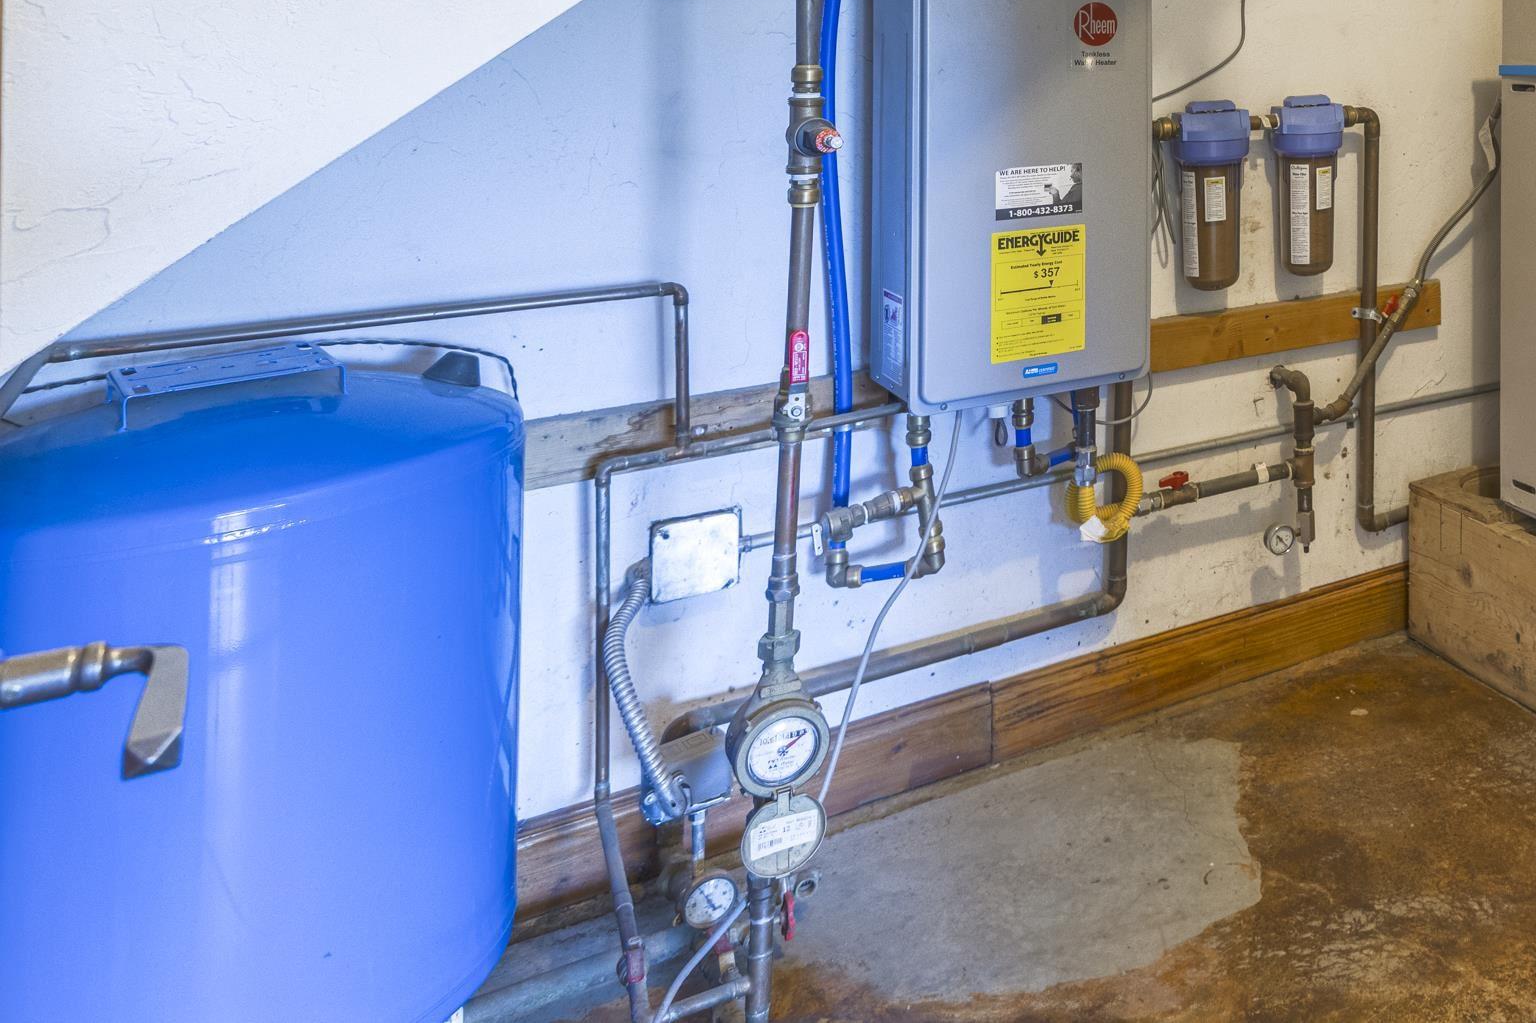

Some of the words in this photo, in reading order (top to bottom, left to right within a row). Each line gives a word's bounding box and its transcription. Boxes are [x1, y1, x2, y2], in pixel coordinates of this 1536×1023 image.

[1078, 3, 1116, 40] Rheem
[1081, 50, 1111, 58] Tankless
[1009, 204, 1073, 218] 1-800-432-8373
[998, 230, 1080, 252] ENERGYGUIDE
[1033, 270, 1039, 279] $
[1040, 266, 1060, 278] 357
